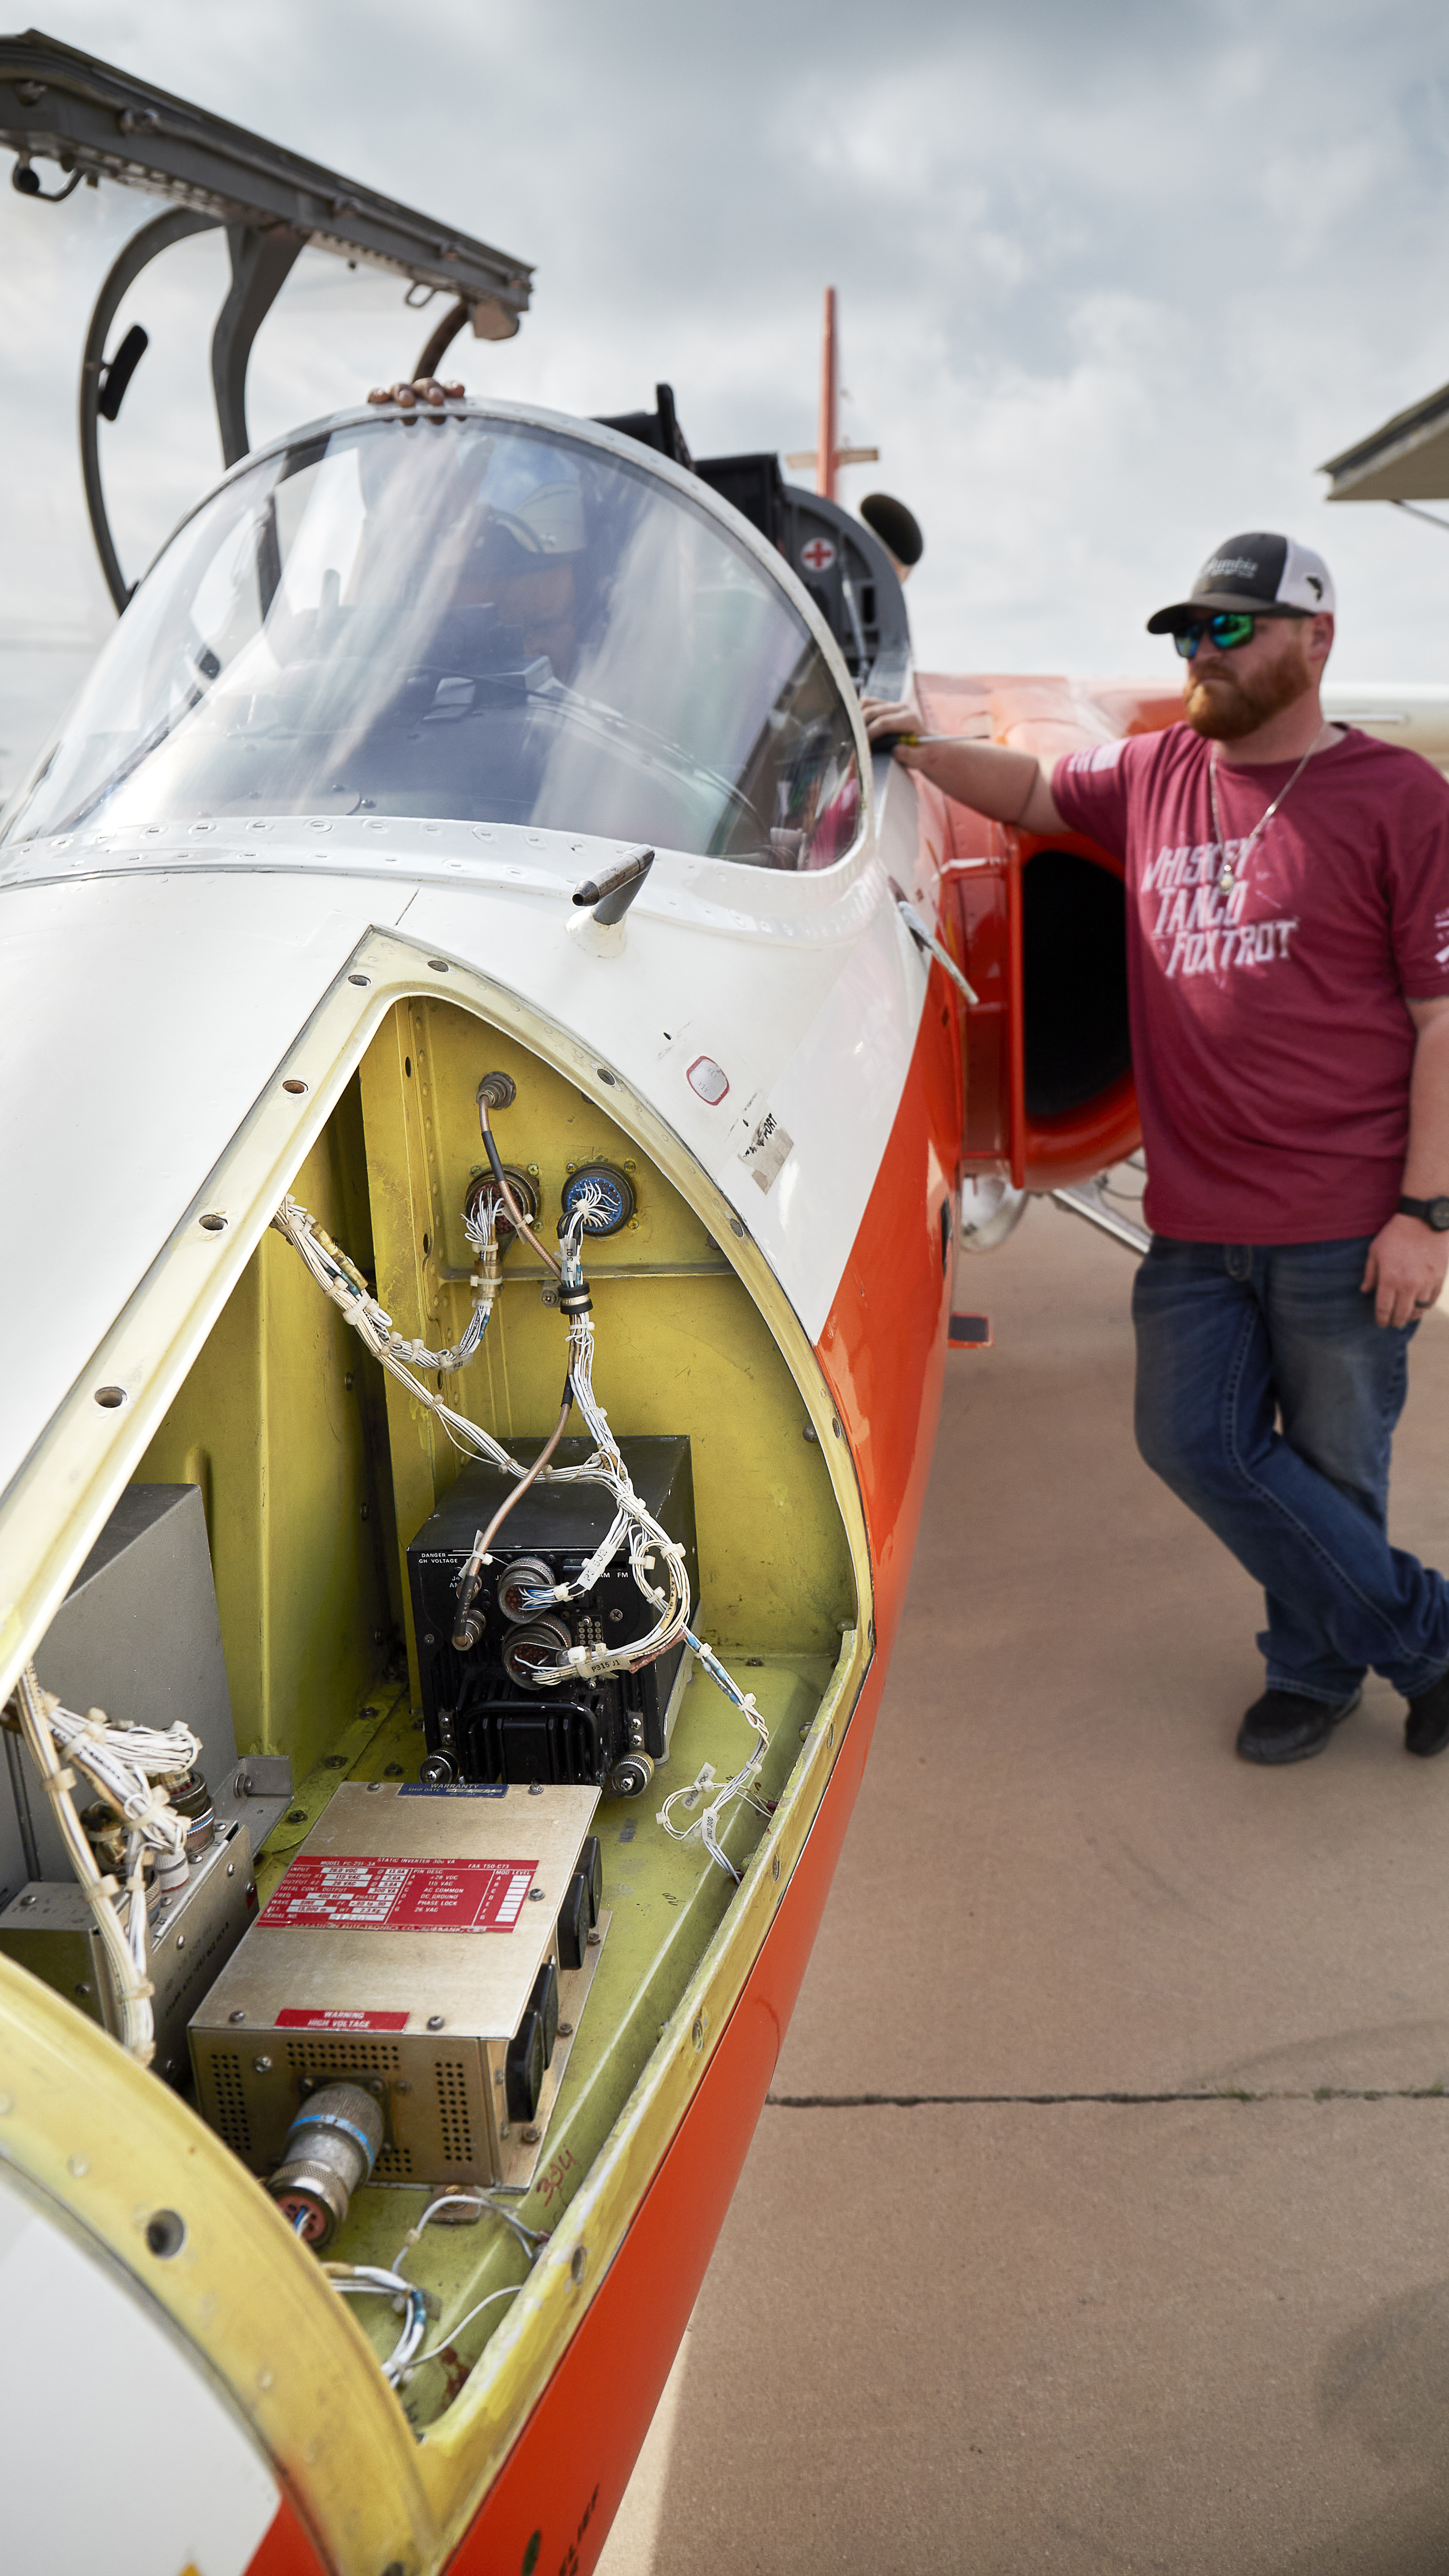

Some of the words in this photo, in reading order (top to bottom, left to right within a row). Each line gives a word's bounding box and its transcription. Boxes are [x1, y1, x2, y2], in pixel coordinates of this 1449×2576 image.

[1164, 919, 1298, 979] FOXTROT
[592, 1662, 610, 1672] P315
[332, 2020, 371, 2028] VOLTAGE
